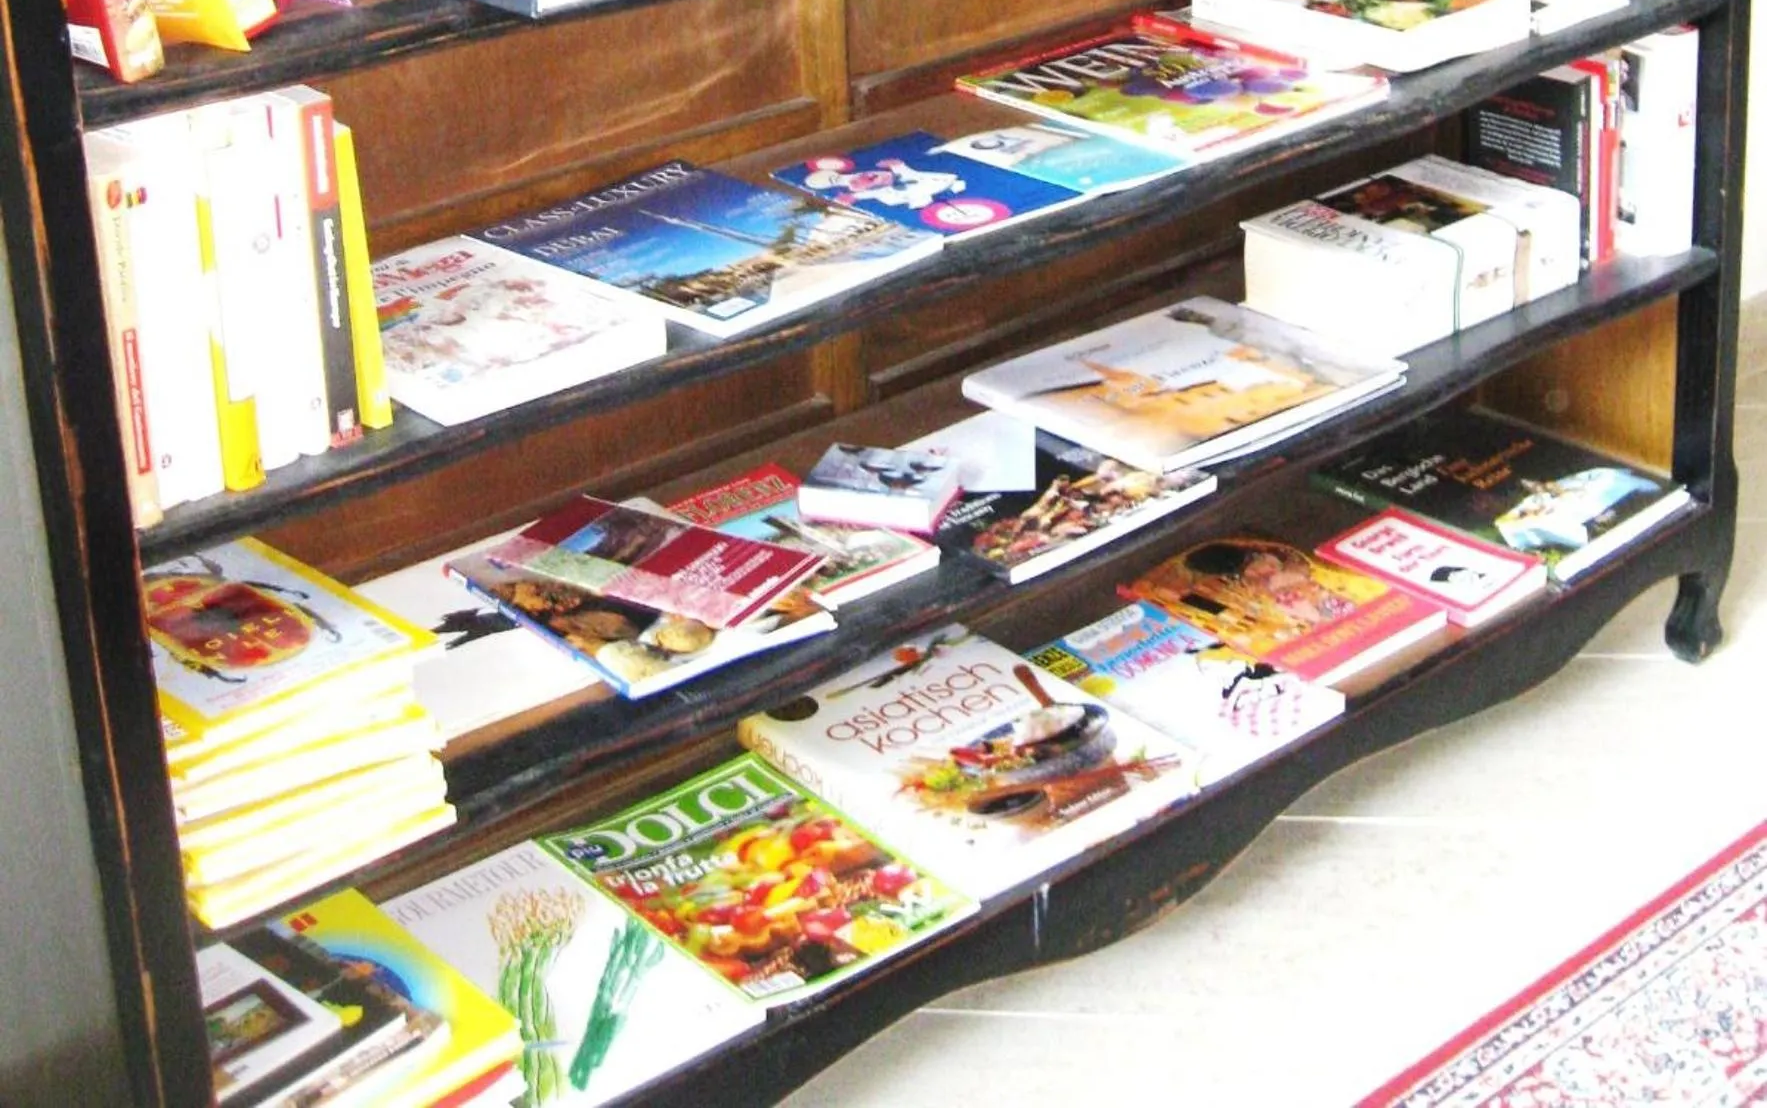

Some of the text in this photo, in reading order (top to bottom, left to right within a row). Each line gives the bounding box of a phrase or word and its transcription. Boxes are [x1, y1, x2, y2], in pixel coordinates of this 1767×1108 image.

[999, 37, 1190, 93] WEIN
[825, 657, 1003, 743] asiatisch
[859, 675, 1021, 755] kochen
[584, 772, 778, 862] DOLCI
